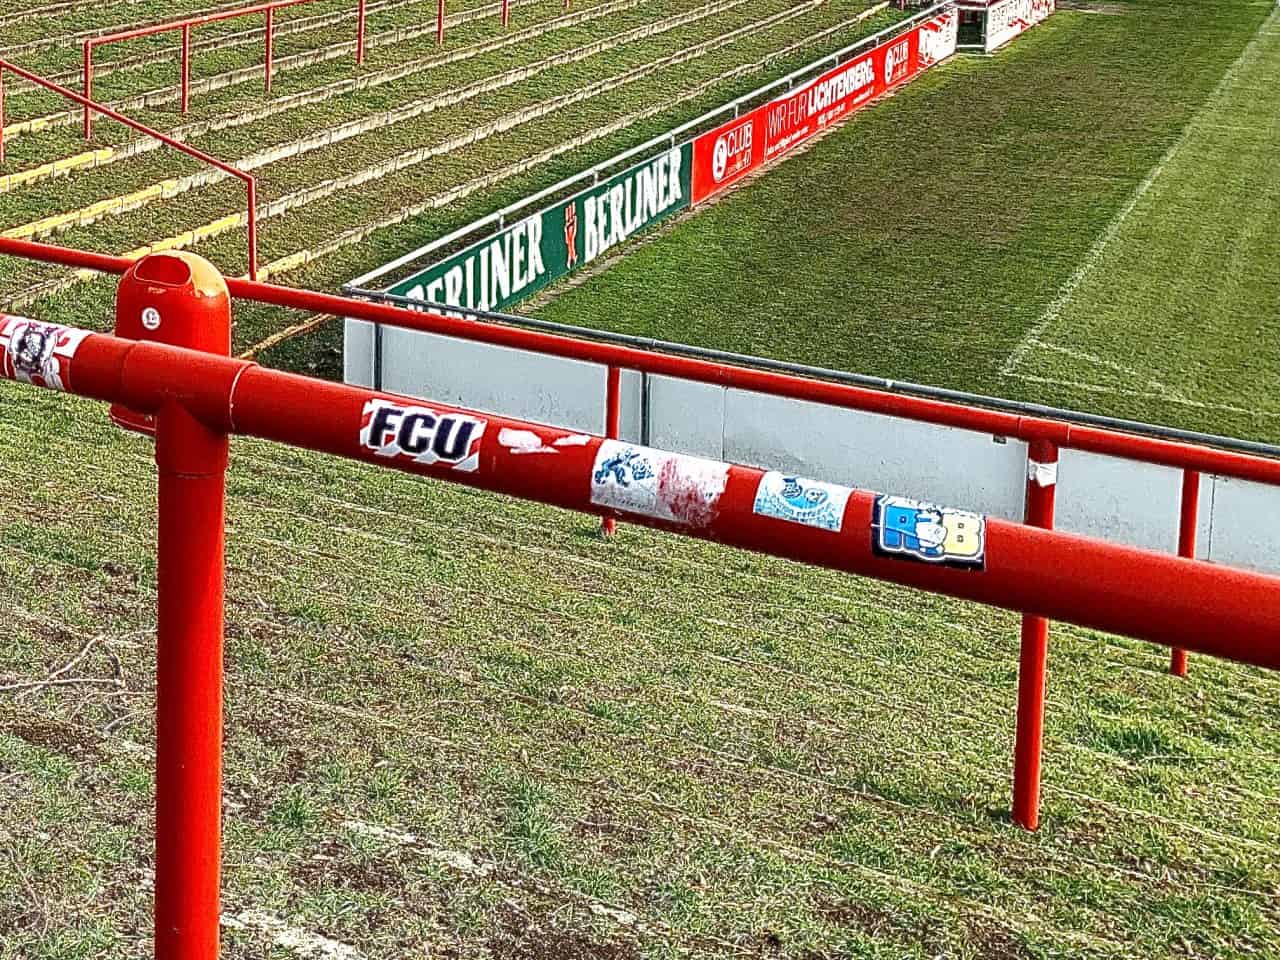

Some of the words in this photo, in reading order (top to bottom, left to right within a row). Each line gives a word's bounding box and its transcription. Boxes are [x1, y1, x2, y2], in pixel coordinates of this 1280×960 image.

[727, 123, 753, 158] CLUB
[768, 103, 787, 137] WIR
[583, 148, 683, 264] BERLINER
[368, 406, 476, 461] FCU
